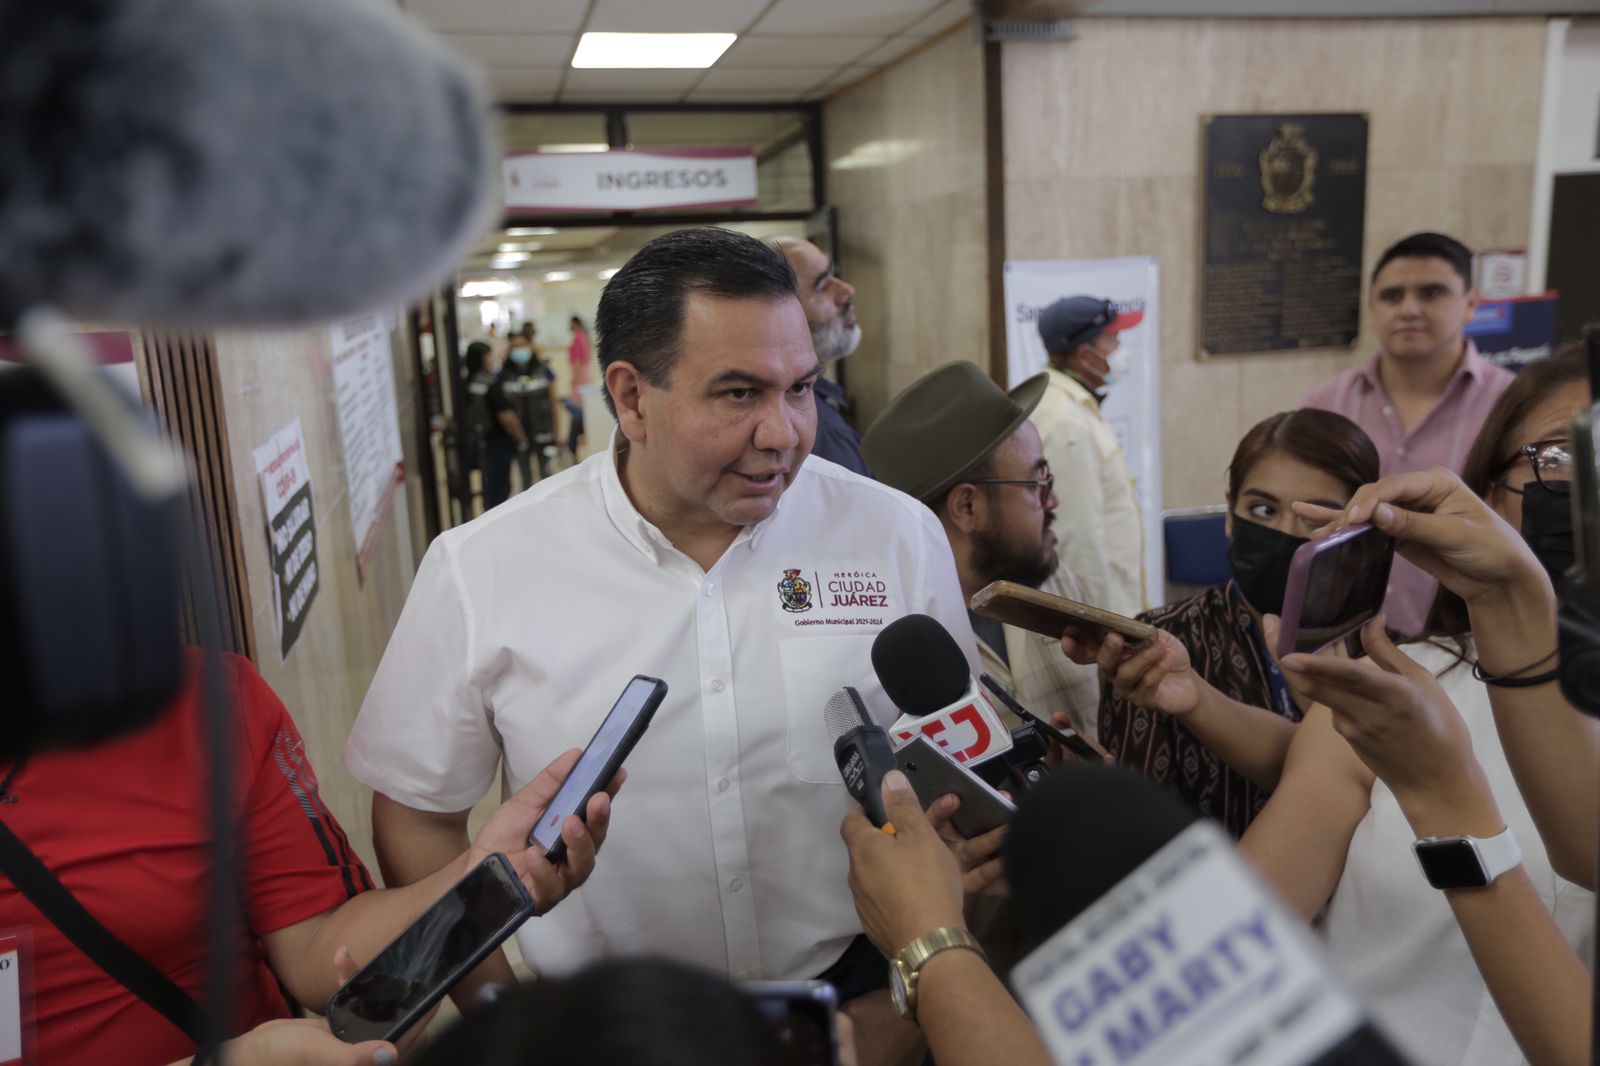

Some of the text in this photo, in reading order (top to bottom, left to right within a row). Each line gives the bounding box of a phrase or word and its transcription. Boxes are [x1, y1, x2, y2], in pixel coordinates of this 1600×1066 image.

[596, 168, 729, 191] INGRESOS
[833, 570, 877, 578] HERÓICA
[828, 580, 886, 593] CIUDAD
[830, 592, 888, 607] JUÁREZ
[795, 617, 883, 626] Gobierno Municipal 2021-2024
[1053, 908, 1177, 1036] GABY
[1104, 909, 1276, 1064] MARTY
